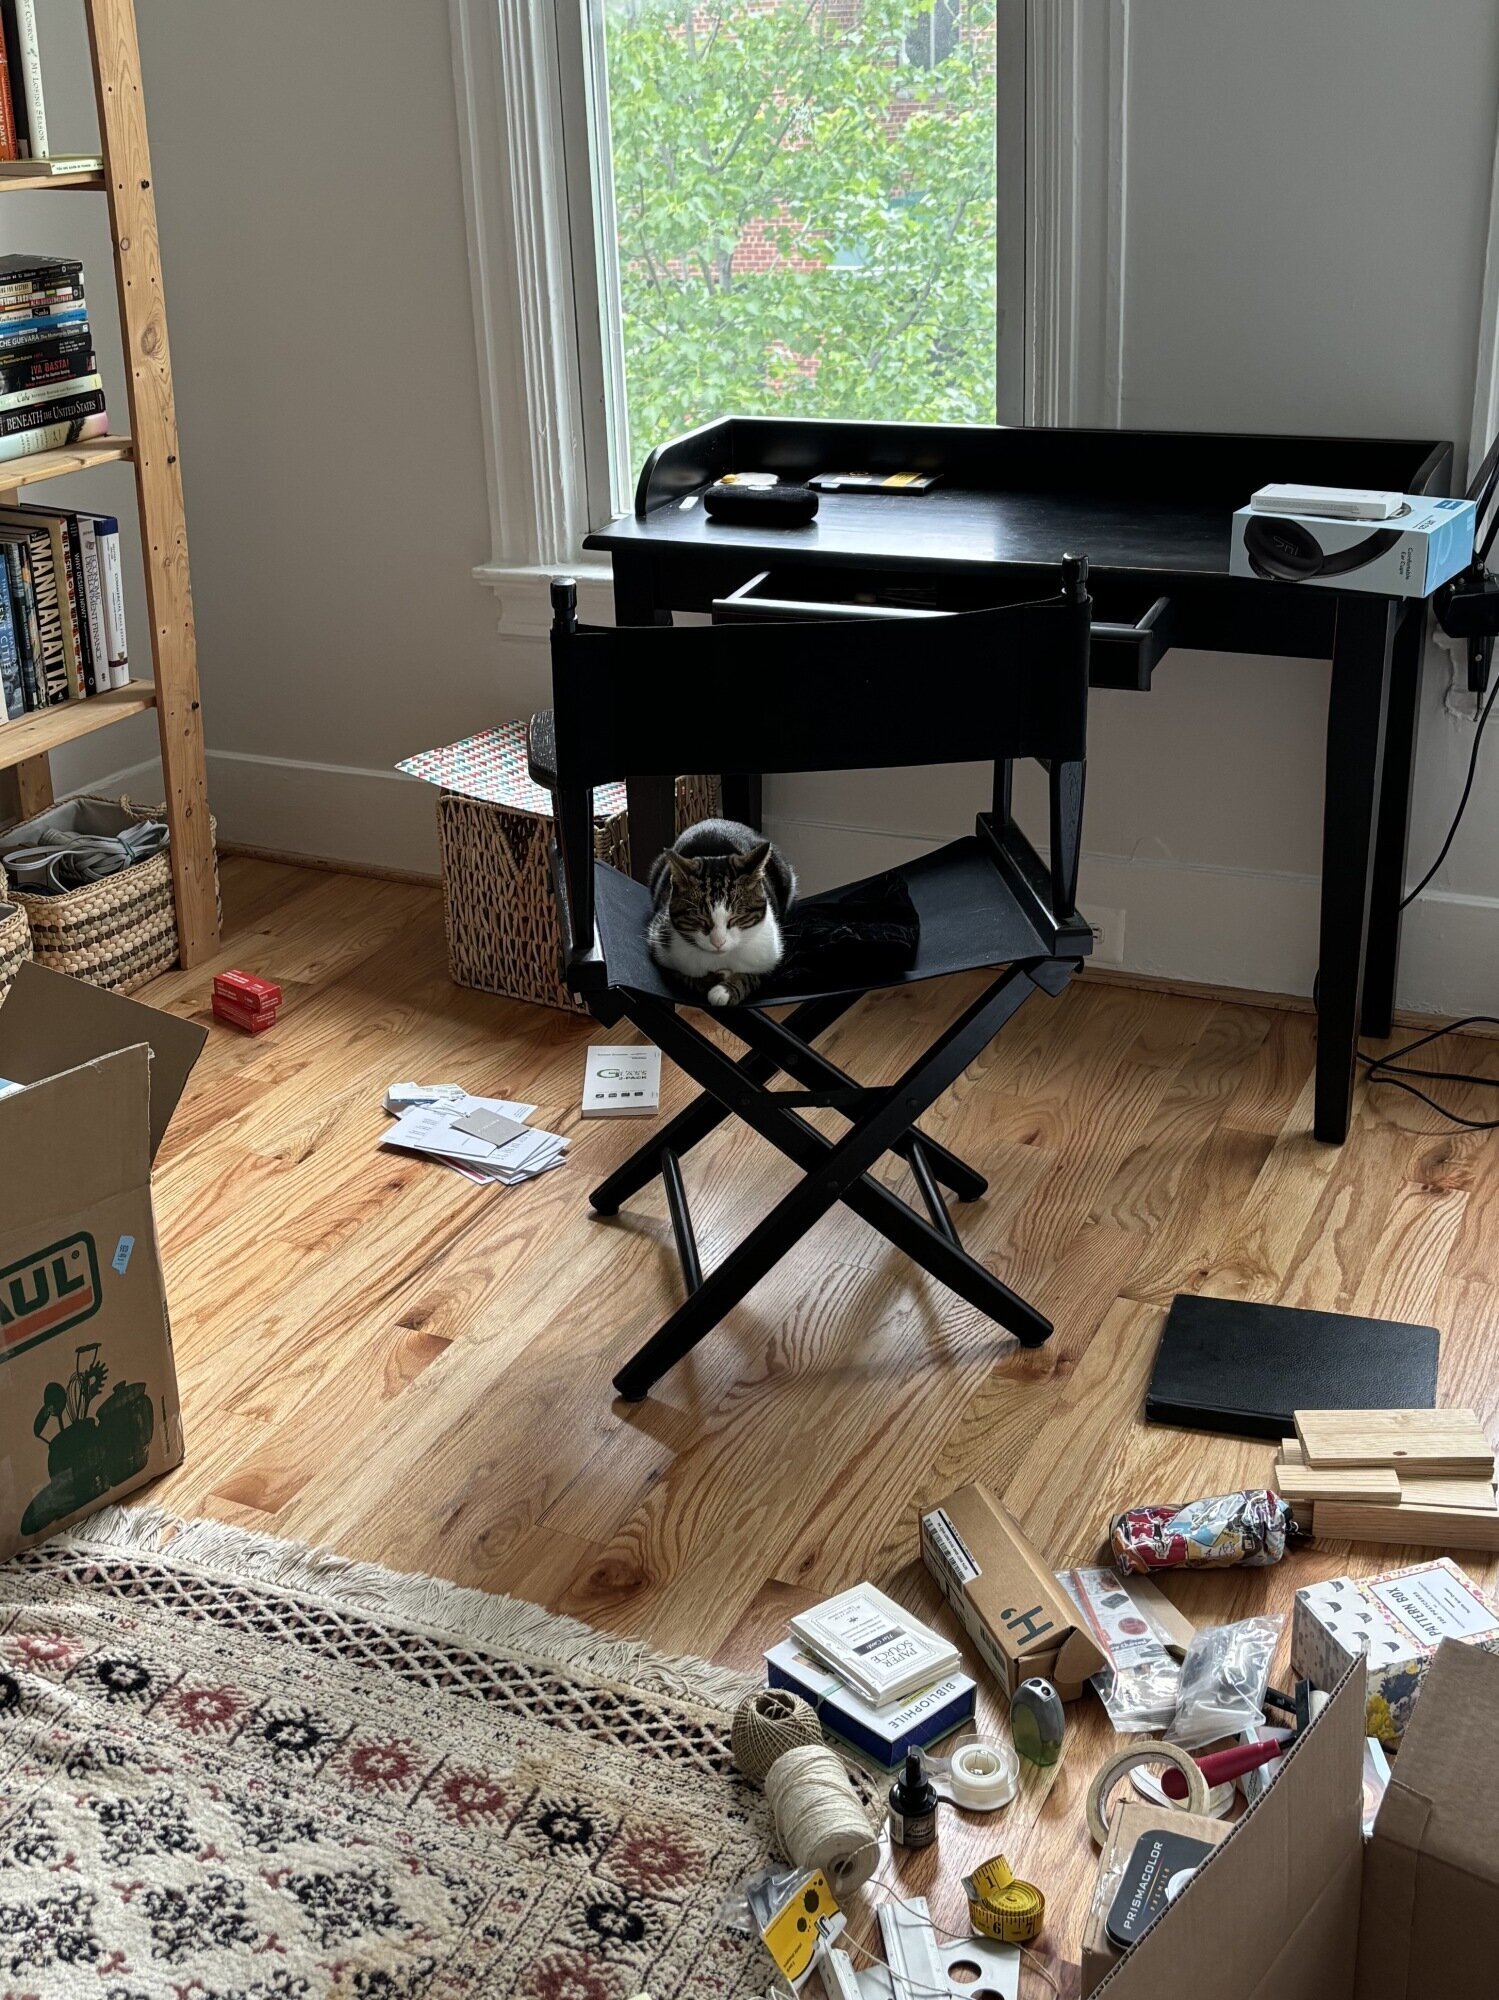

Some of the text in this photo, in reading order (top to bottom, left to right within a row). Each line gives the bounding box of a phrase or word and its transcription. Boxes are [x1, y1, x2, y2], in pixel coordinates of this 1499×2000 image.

[32, 77, 41, 106] LOSING
[36, 110, 45, 141] SEASON
[12, 334, 39, 345] GUEVARA
[7, 410, 43, 431] BENEATH
[53, 406, 76, 419] UNITED
[76, 401, 96, 413] STATES
[1398, 561, 1406, 576] Cups
[1405, 547, 1414, 582] Comfortable
[76, 571, 84, 596] DESIGN
[30, 534, 68, 694] MANNAHATTA
[86, 556, 102, 662] DEVELOPMENT FINANCE
[0, 636, 11, 675] CITIES
[1387, 1587, 1409, 1607] BOX
[1412, 1591, 1437, 1616] POSTCARDS
[1402, 1603, 1443, 1637] PATTERN
[871, 1639, 913, 1664] SOURCE
[884, 1647, 917, 1667] PAPER
[889, 1682, 956, 1729] BIBLIOPHILE
[986, 1875, 994, 1888] 1
[1124, 1841, 1162, 1930] PRISMACOLOR
[1148, 1866, 1170, 1912] PREMIER
[992, 1921, 1032, 1935] 6 7
